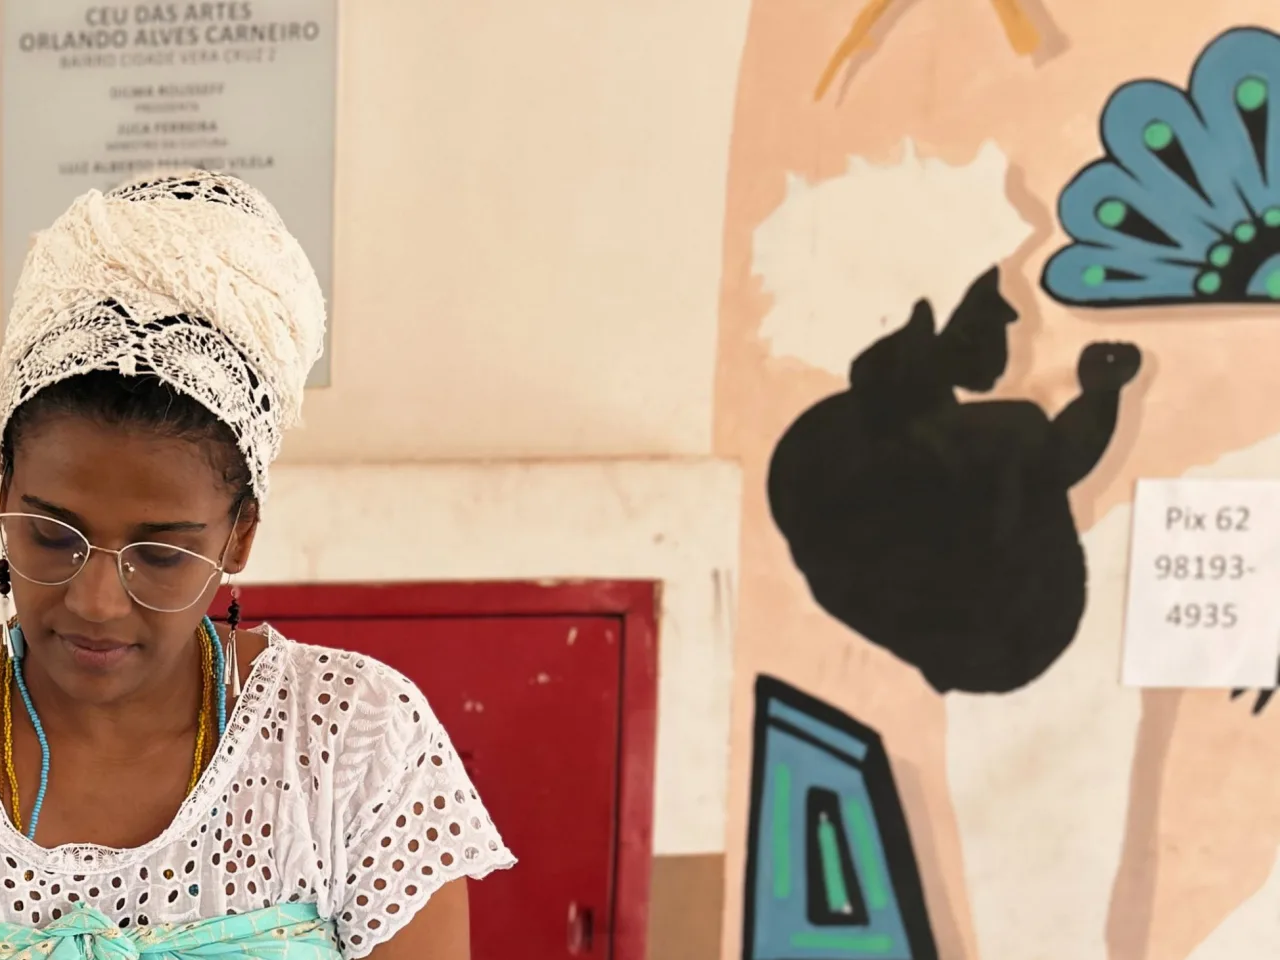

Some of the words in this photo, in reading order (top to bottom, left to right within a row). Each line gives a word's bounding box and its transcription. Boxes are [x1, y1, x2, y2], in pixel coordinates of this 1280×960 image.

[86, 6, 128, 27] CEU
[135, 4, 177, 25] DAS
[184, 1, 251, 23] ARTES
[20, 29, 127, 52] ORLANDO
[132, 26, 198, 47] ALVES
[206, 22, 319, 45] CARNEIRO
[60, 53, 116, 70] BAIRRO
[120, 51, 175, 68] CIDADE
[180, 50, 218, 65] VERA
[223, 48, 263, 64] CRUZ
[1165, 506, 1207, 531] Pix
[1215, 506, 1250, 532] 62
[1154, 554, 1256, 581] 98193-
[1165, 602, 1238, 629] 4935
